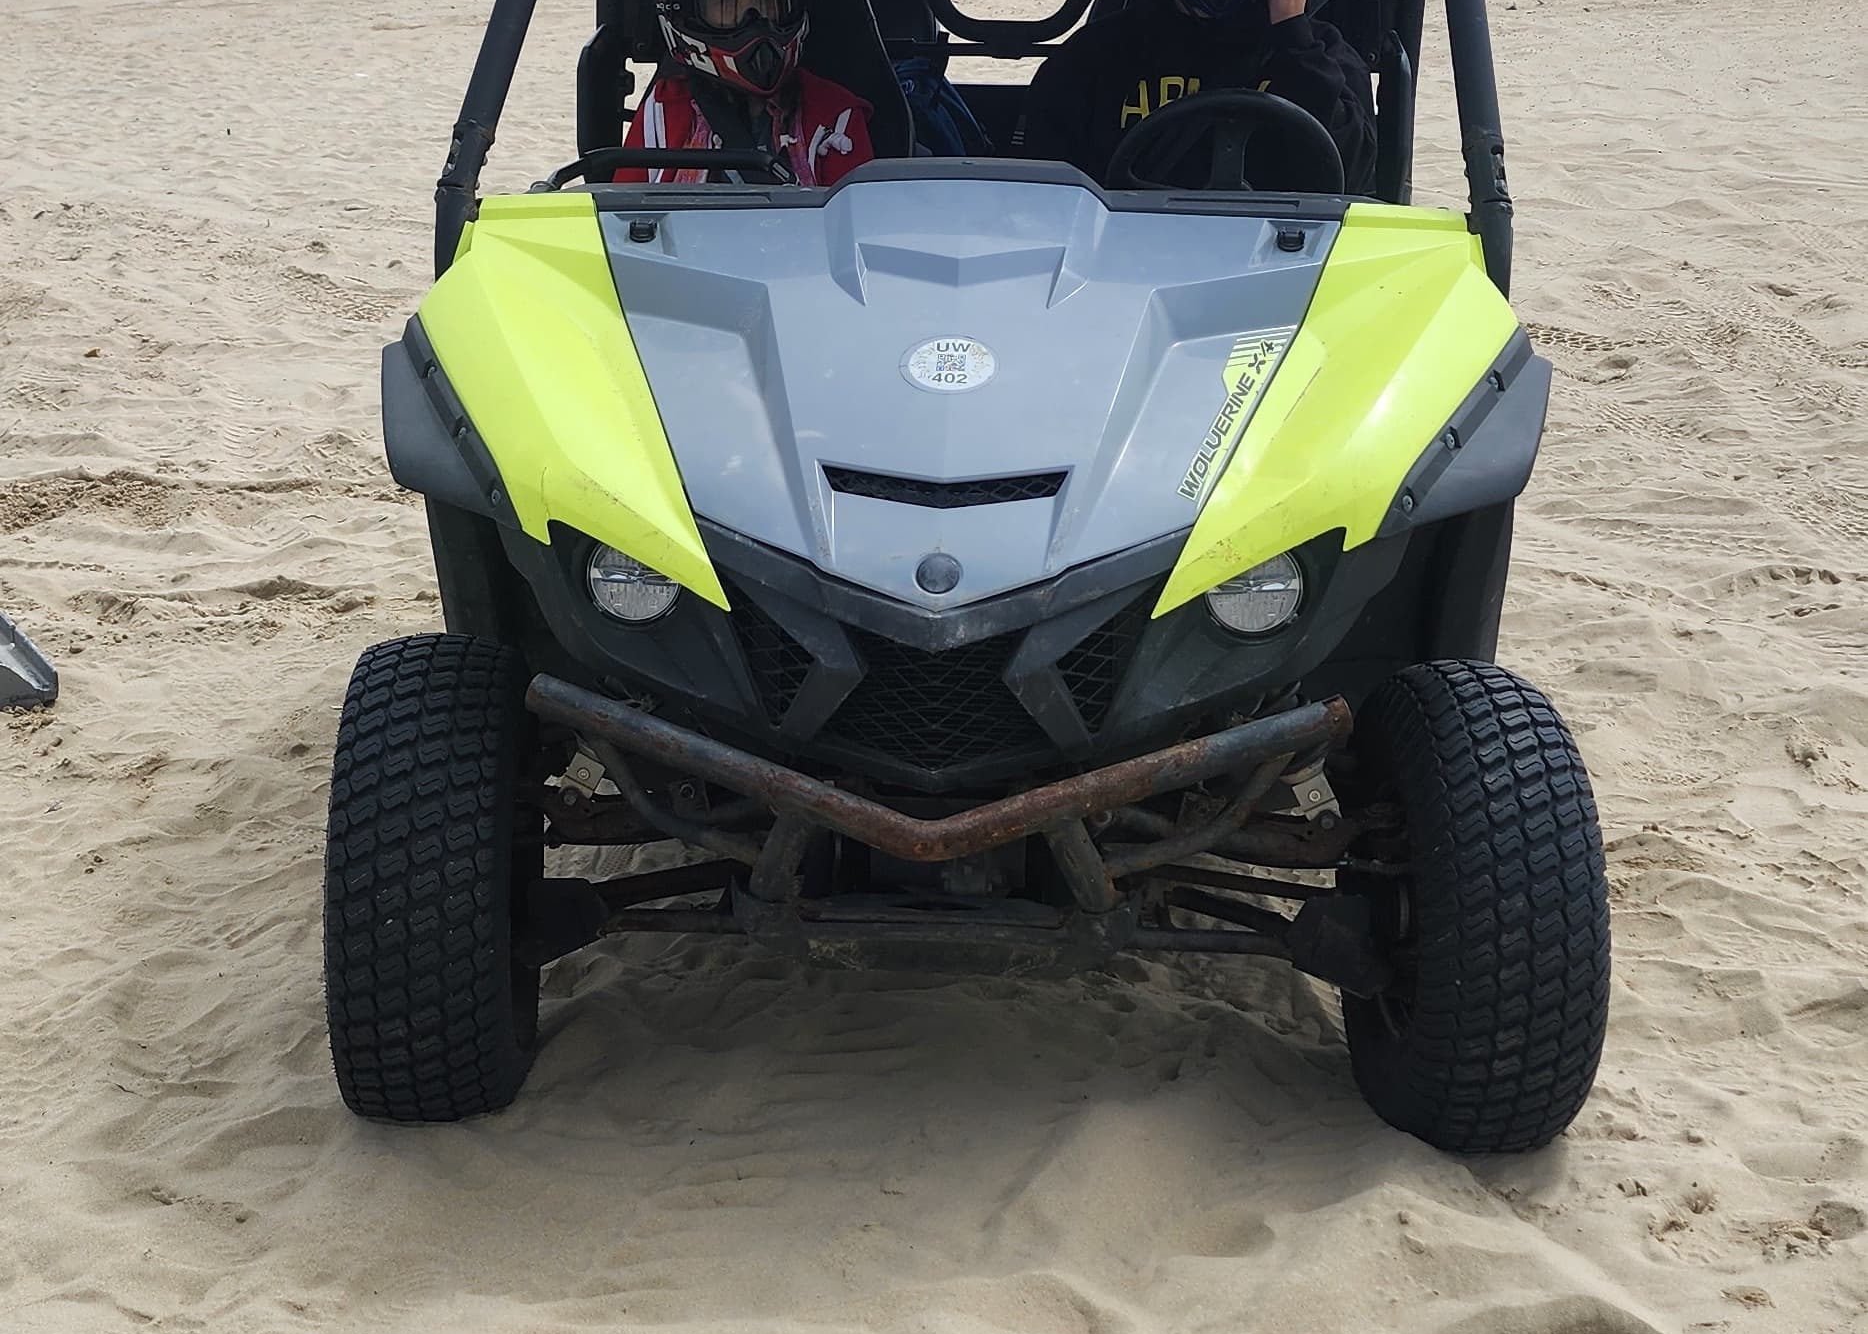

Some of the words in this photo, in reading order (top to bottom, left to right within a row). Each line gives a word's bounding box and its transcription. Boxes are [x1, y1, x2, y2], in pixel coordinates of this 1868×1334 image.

[1120, 76, 1271, 129] AR
[936, 342, 971, 353] UW
[931, 373, 968, 384] 402
[1179, 371, 1256, 500] WOLVERINE
